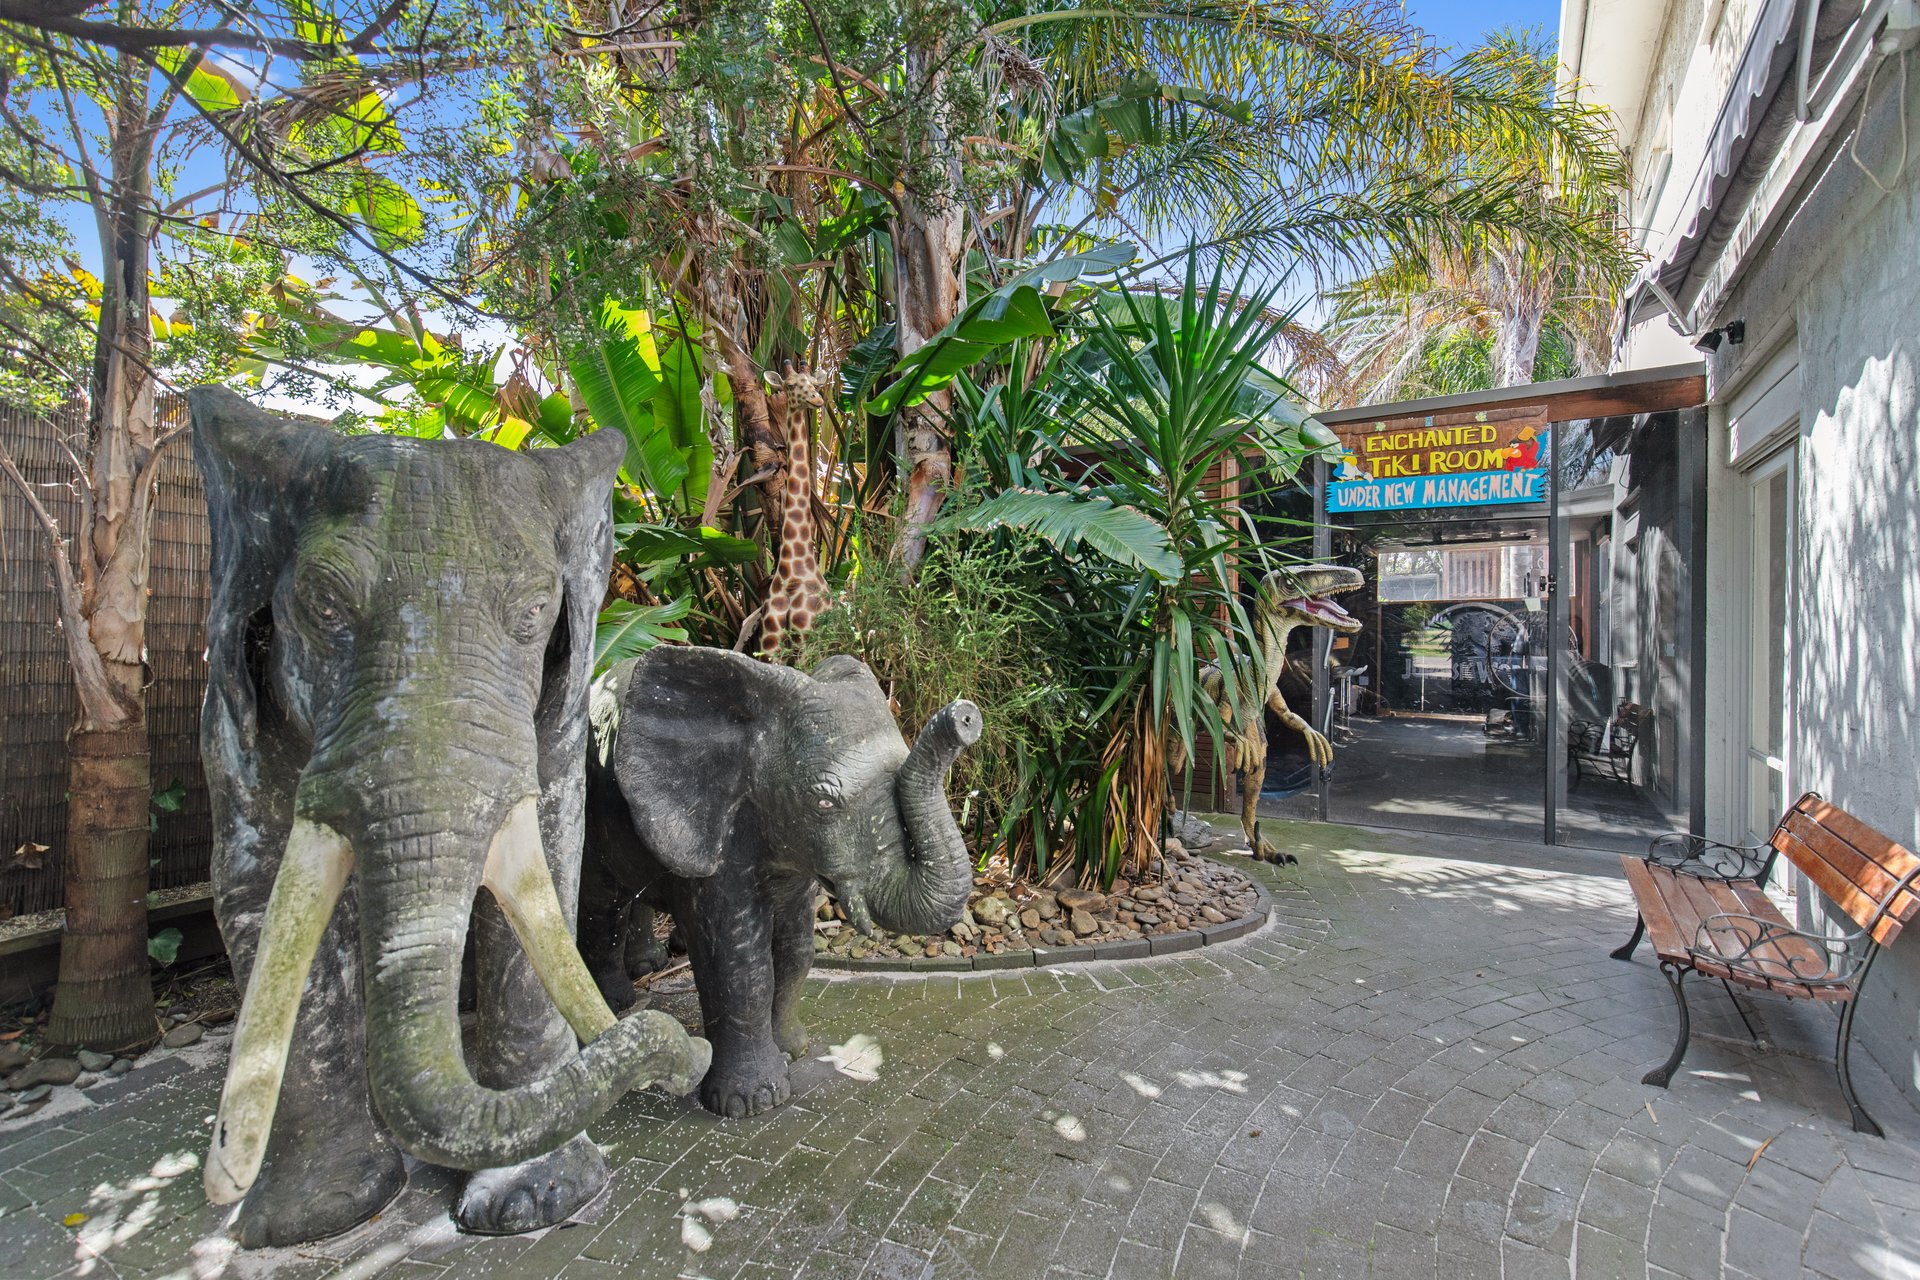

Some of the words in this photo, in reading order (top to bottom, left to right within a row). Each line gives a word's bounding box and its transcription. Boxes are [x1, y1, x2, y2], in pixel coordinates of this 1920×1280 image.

[1366, 425, 1497, 452] ENCHANTED
[1366, 454, 1421, 478] TIKI
[1429, 448, 1503, 473] ROOM
[1338, 485, 1381, 508] UNDER
[1384, 480, 1416, 507] NEW
[1422, 471, 1540, 505] MANAGEMENT
